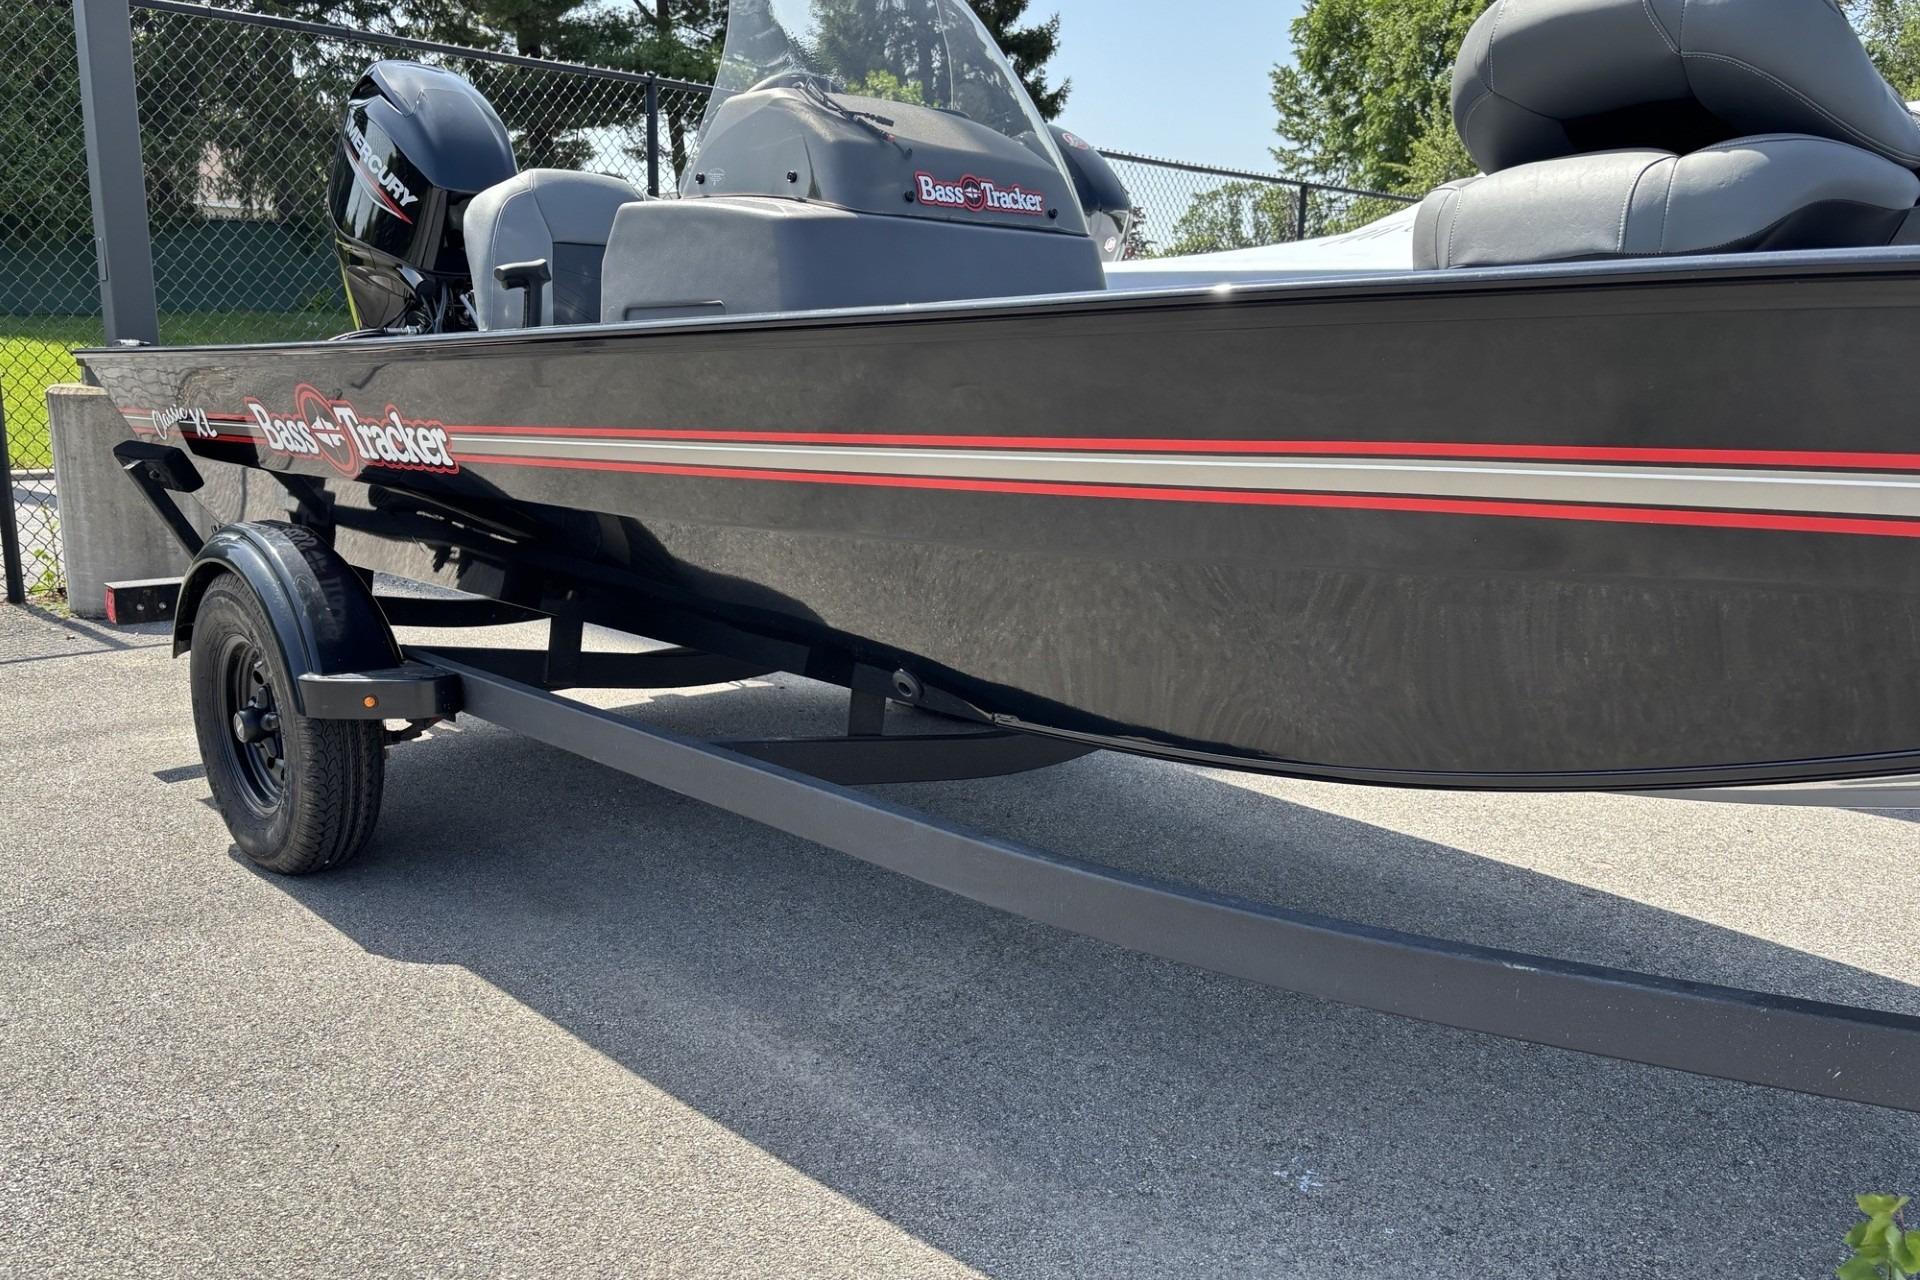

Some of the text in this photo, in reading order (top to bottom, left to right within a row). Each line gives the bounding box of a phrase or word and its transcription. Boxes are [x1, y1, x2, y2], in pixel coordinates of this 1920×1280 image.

[344, 107, 419, 207] MERCURY
[918, 174, 1042, 212] Bass Tracker
[151, 403, 218, 441] Classic XL
[248, 402, 454, 467] Bass Tracker
